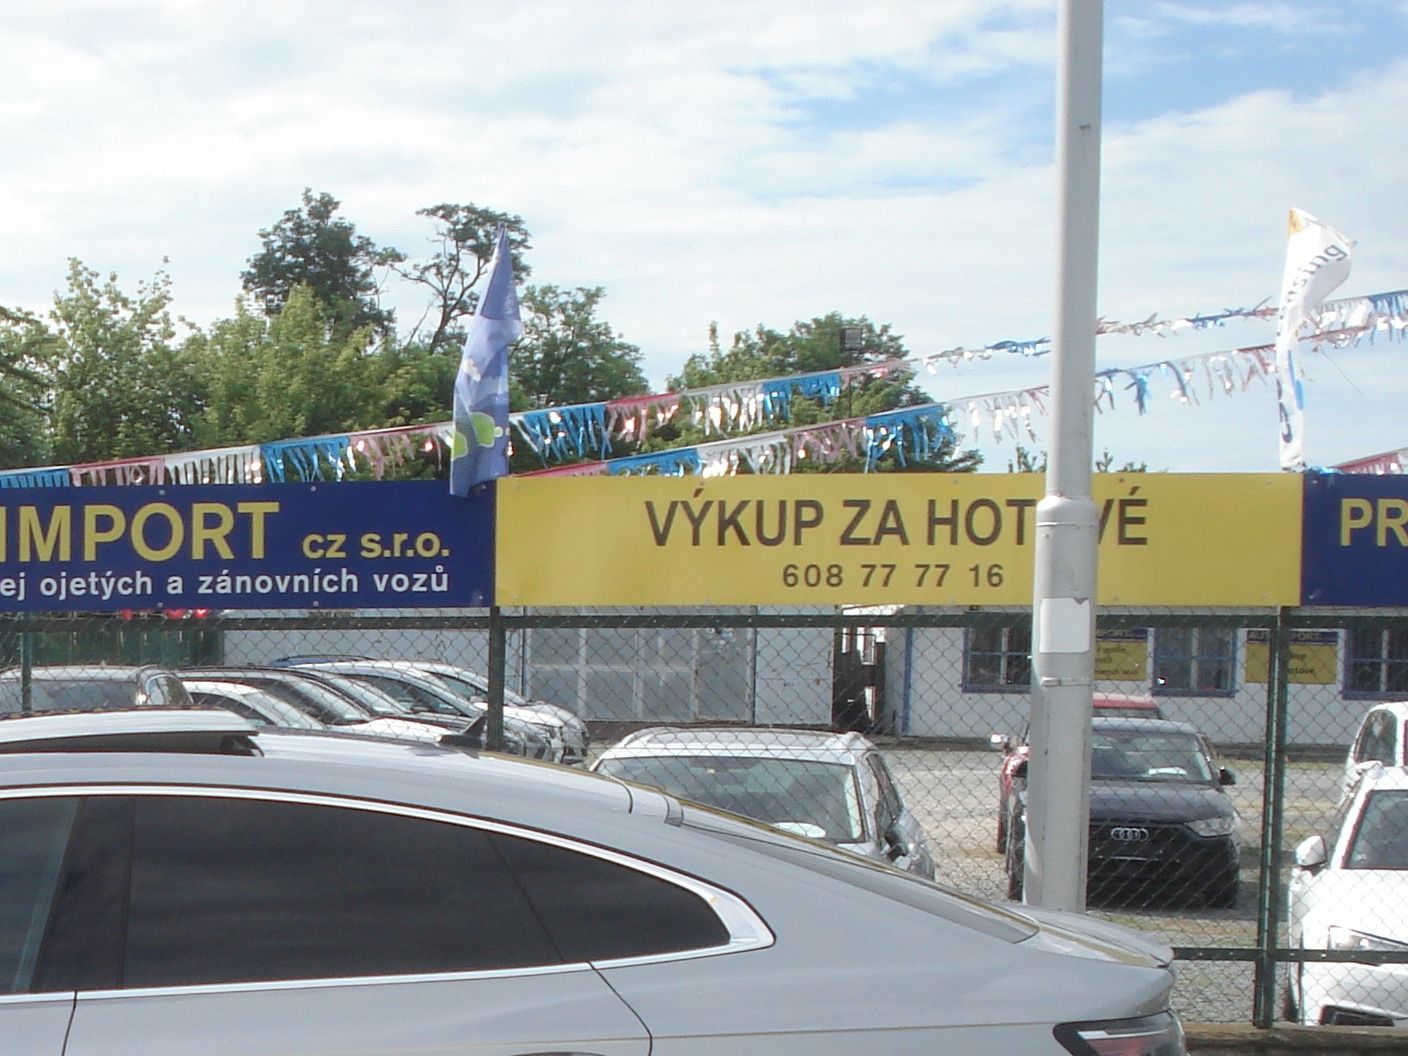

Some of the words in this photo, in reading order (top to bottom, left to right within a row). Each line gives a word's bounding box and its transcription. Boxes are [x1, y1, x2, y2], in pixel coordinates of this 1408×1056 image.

[644, 487, 824, 547] VÝKUP
[839, 498, 911, 546] ZA
[927, 486, 1149, 546] HOTVÉ
[301, 533, 347, 560] cz
[359, 531, 451, 559] s.r.o.
[40, 570, 153, 601] ojetých
[166, 574, 184, 595] a
[197, 567, 359, 596] zánovních
[372, 565, 449, 593] vozů
[782, 563, 843, 588] 608
[860, 563, 897, 588] 77
[914, 563, 951, 588] 77
[968, 563, 1004, 588] 16
